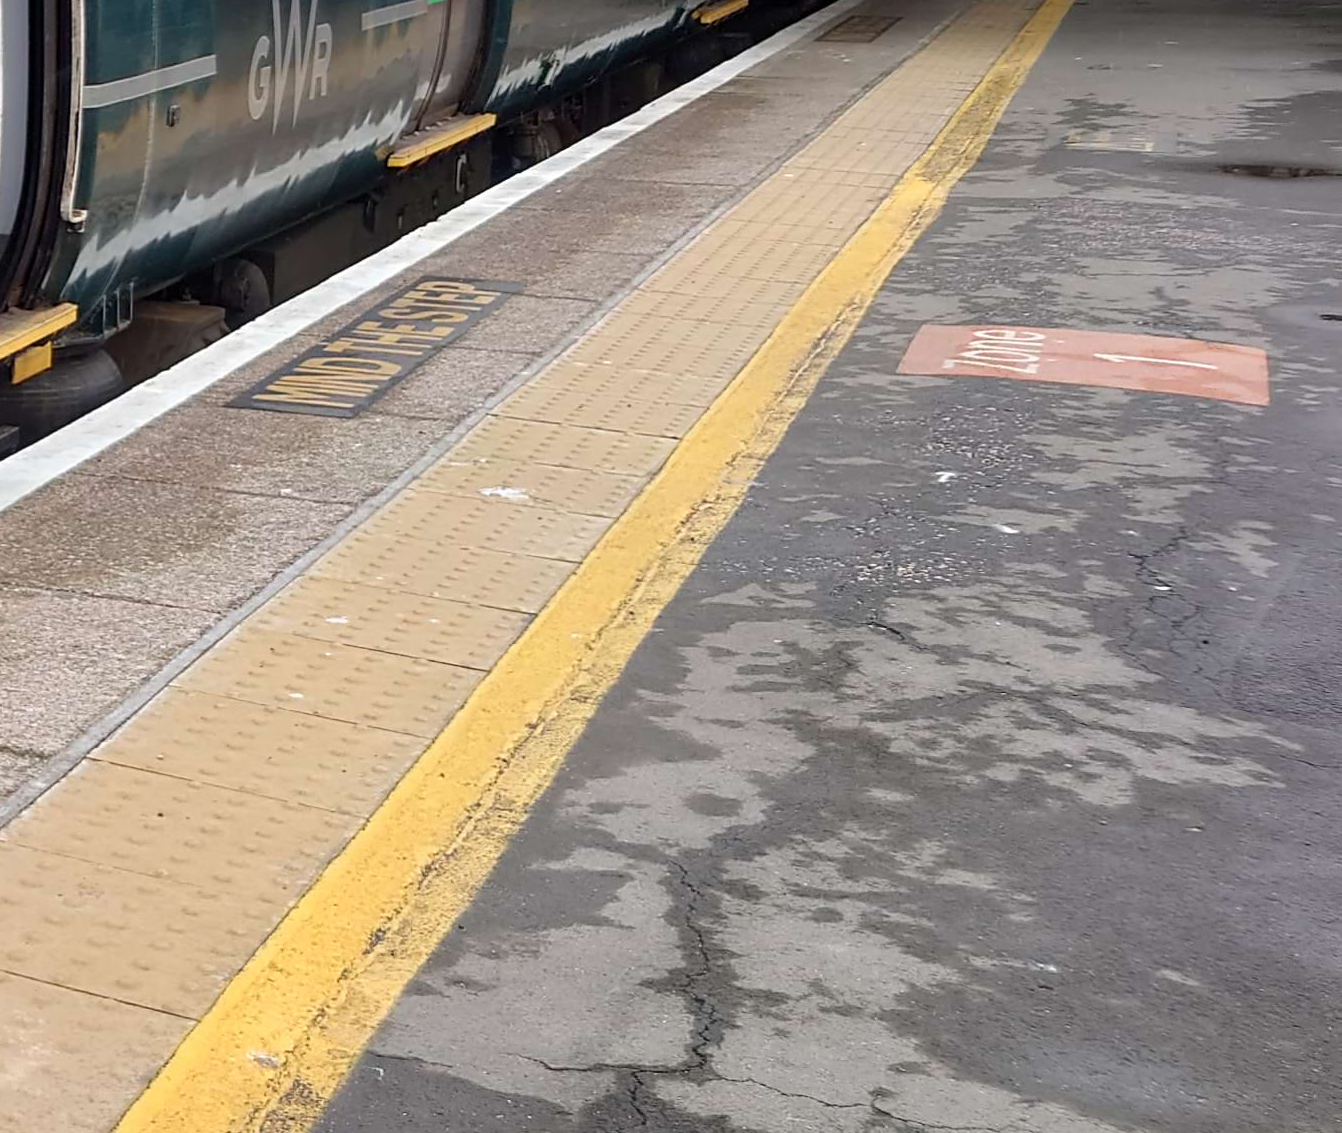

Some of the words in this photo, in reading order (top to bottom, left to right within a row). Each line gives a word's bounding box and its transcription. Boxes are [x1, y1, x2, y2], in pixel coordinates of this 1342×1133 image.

[377, 280, 502, 324] STEP
[322, 320, 456, 356] THE
[251, 356, 403, 408] MIND
